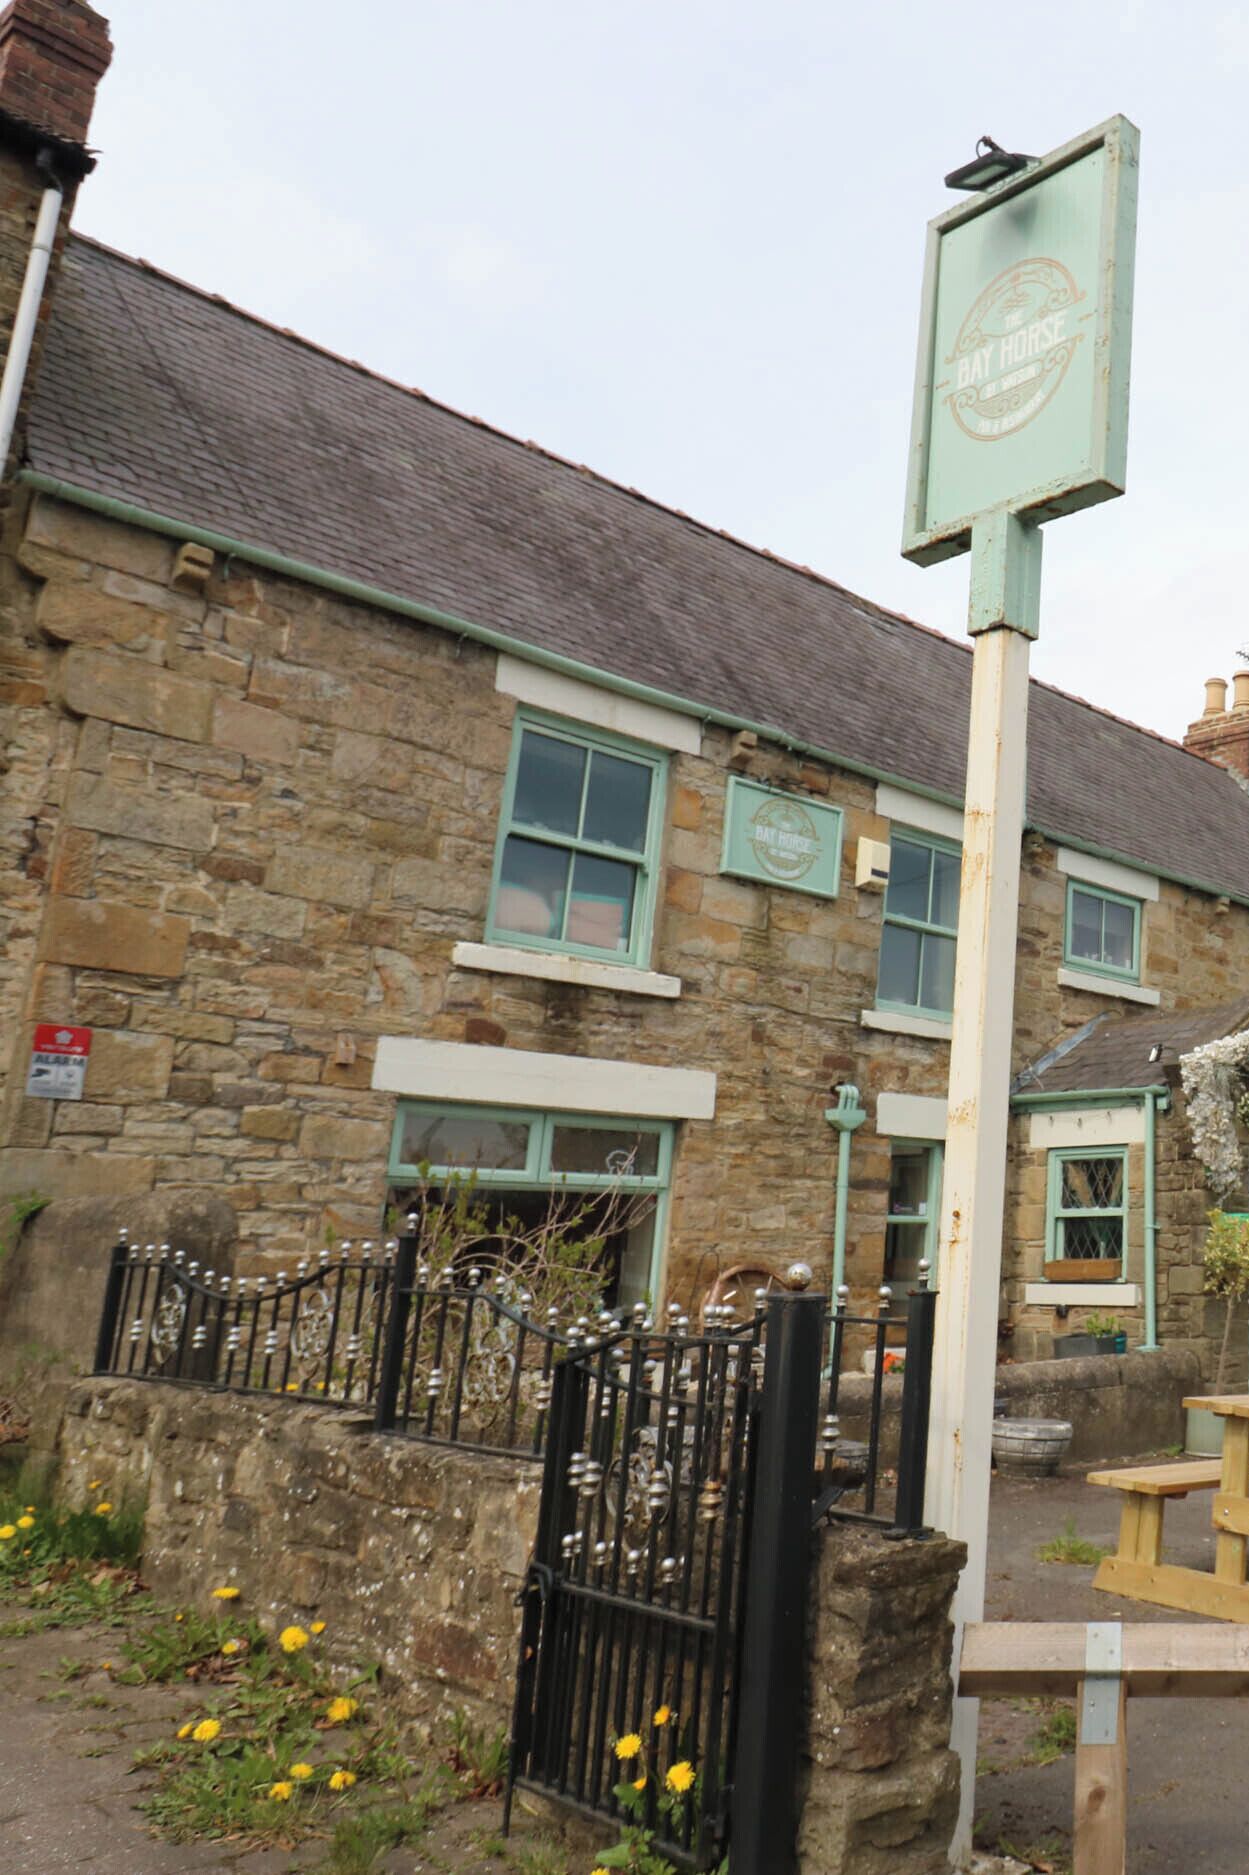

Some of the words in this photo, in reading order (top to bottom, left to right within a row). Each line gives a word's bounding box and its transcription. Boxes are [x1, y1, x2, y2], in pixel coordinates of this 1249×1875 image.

[957, 344, 994, 390] BAY
[1000, 310, 1068, 370] HORSE
[755, 824, 777, 846] BAY
